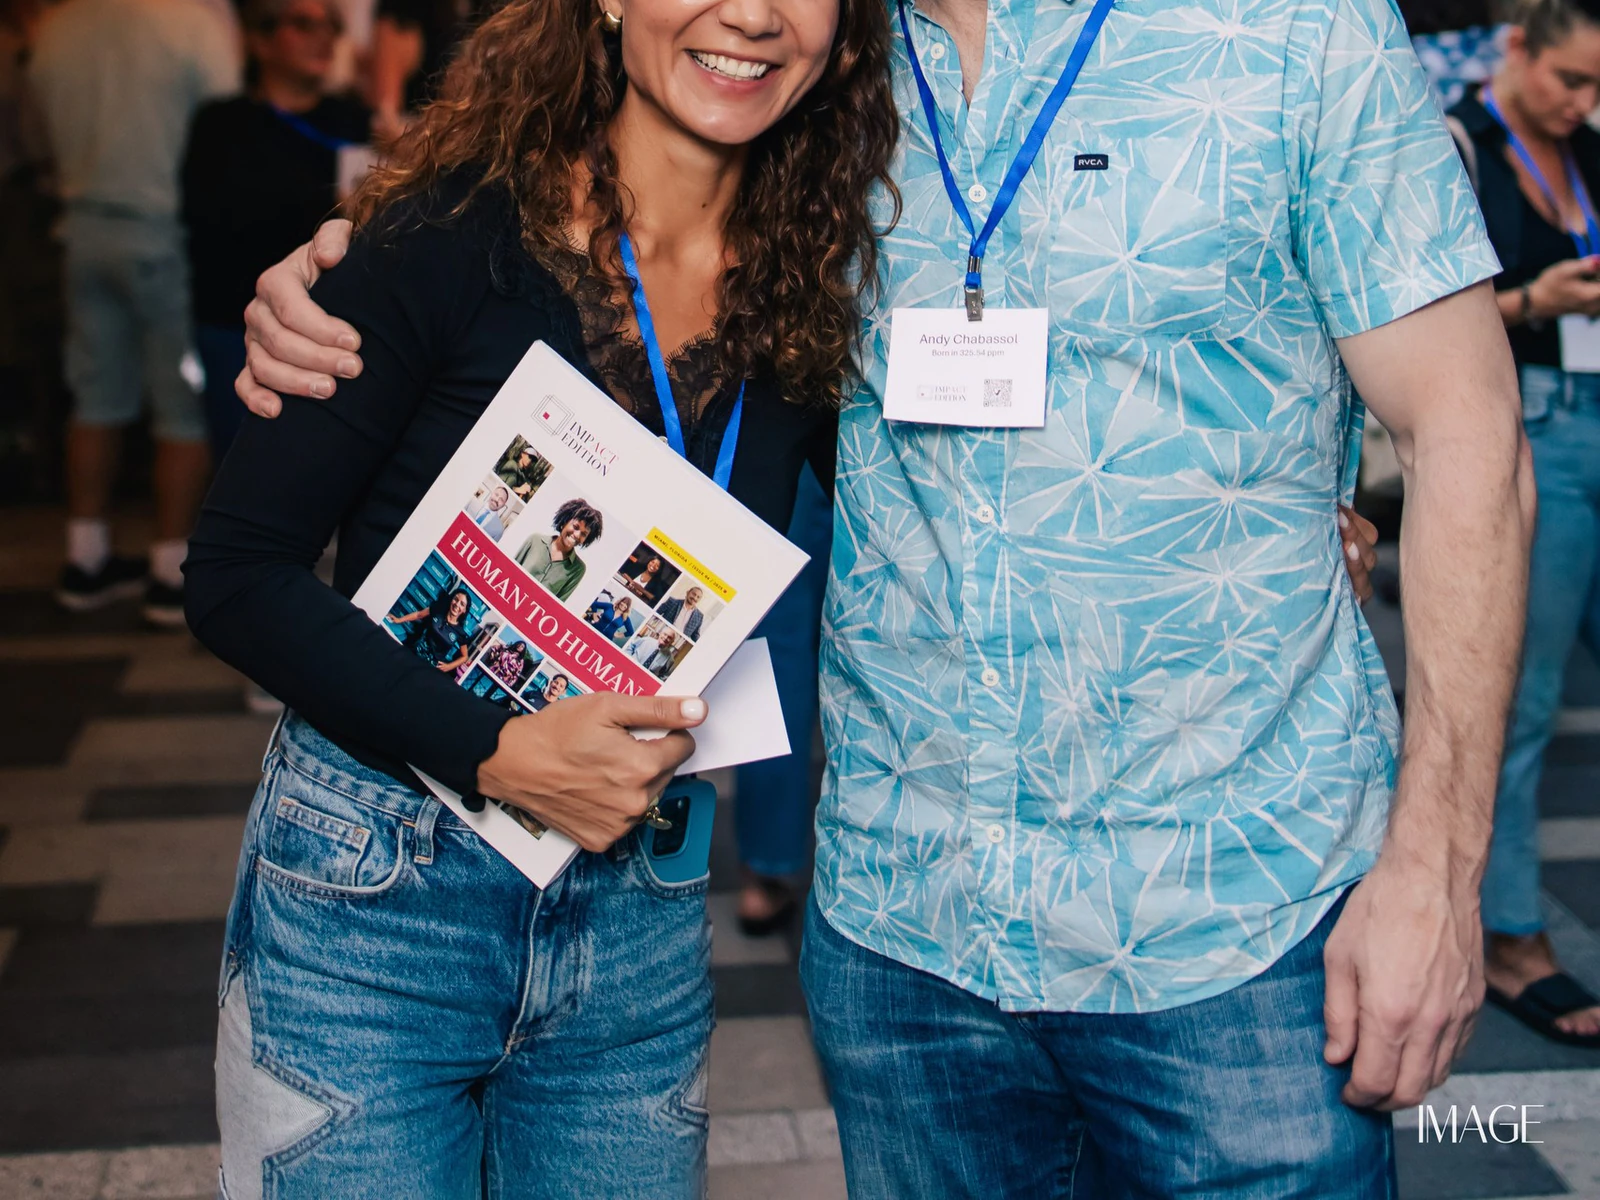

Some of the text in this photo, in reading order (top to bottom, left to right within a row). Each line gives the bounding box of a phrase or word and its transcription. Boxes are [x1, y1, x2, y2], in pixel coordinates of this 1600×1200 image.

[1078, 158, 1104, 166] RVCA
[919, 333, 1018, 347] Andy Chabassol
[931, 349, 949, 357] Born
[561, 432, 611, 477] EDITION
[569, 421, 620, 465] IMPACT
[450, 531, 645, 696] HUMAN TO HUMAN
